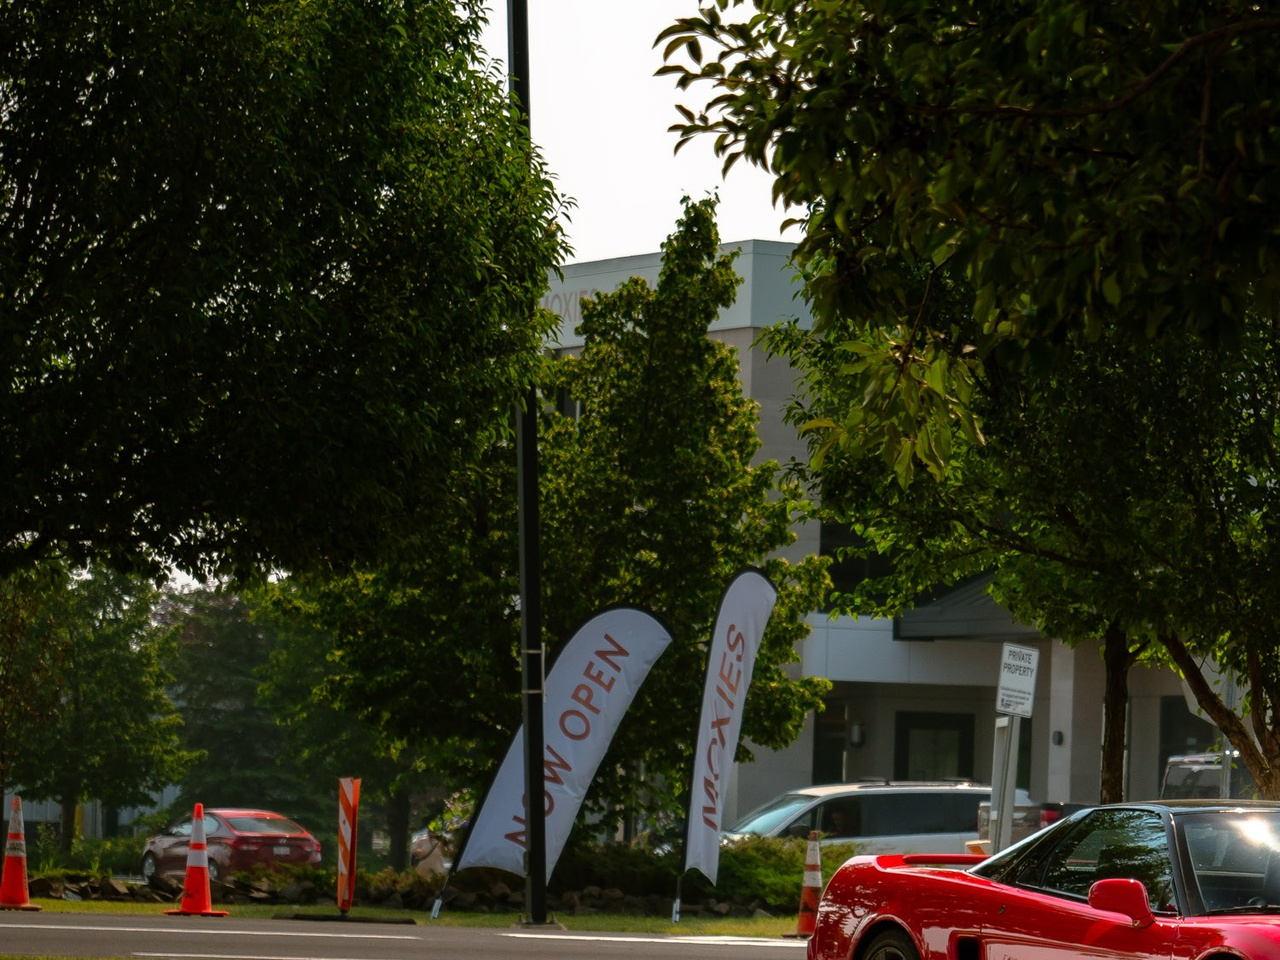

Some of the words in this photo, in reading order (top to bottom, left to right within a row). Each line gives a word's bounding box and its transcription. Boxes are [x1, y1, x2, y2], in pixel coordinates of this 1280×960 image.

[559, 633, 630, 742] OPEN
[1003, 662, 1034, 677] PROPERTY
[1008, 650, 1032, 664] PRIVATE
[702, 623, 745, 832] MOXIES
